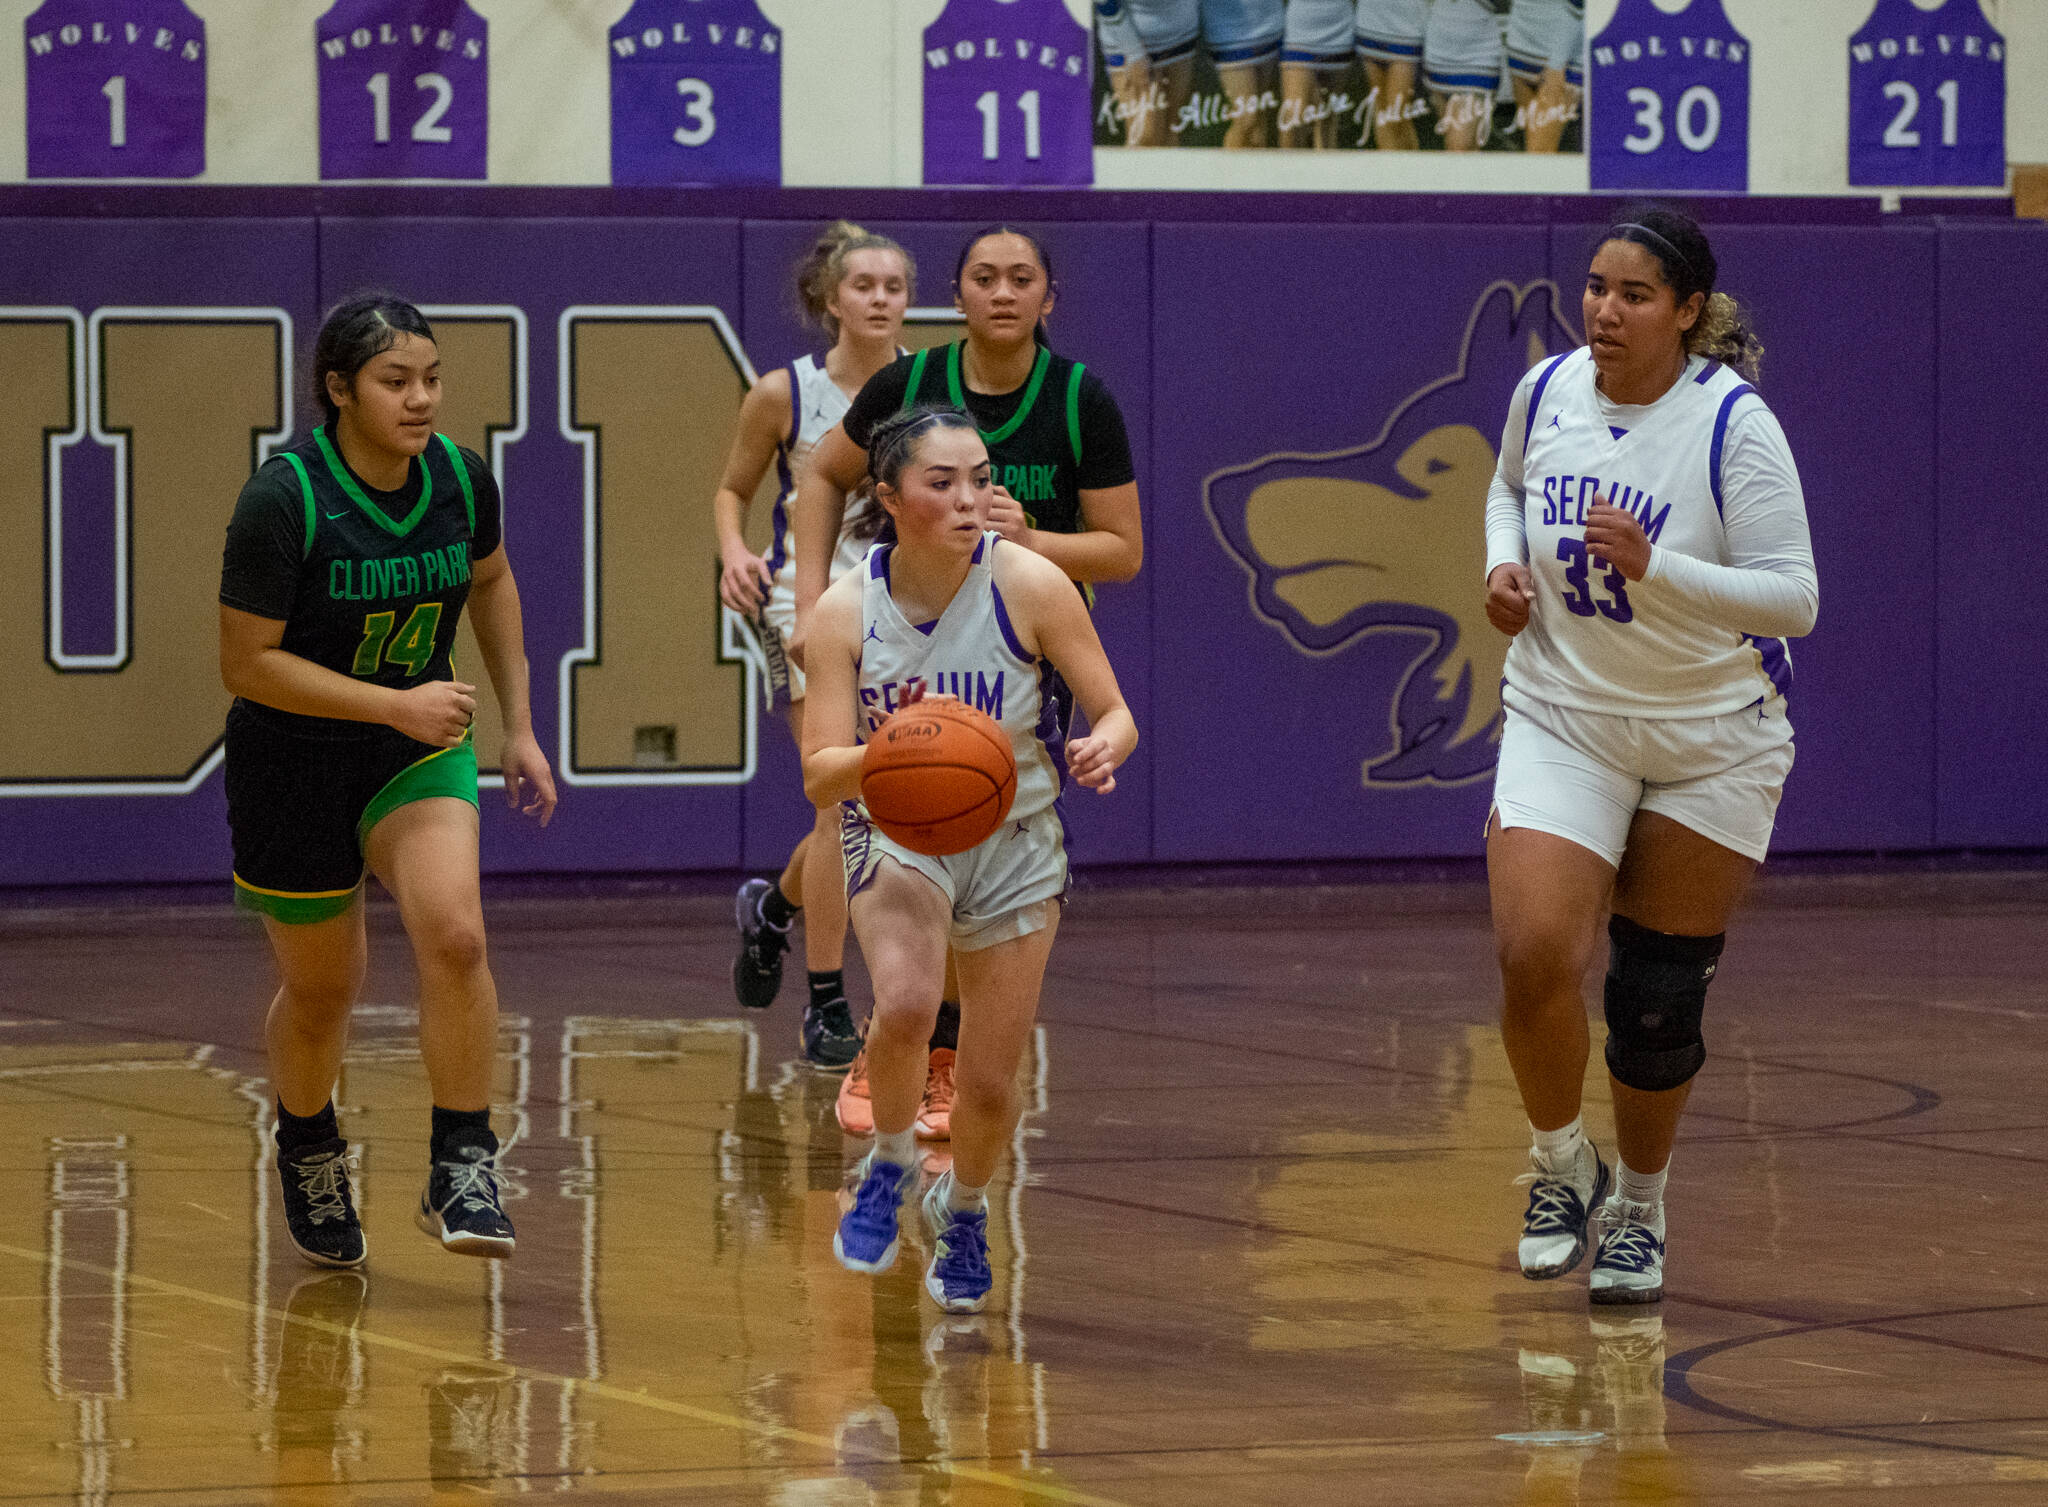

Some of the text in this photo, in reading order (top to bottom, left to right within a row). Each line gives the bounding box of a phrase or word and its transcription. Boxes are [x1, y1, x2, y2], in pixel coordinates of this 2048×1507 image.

[29, 22, 201, 61] WOLVES
[321, 23, 482, 60] WOLVES
[612, 23, 778, 58] WOLVES
[926, 38, 1082, 76] WOLVES
[1594, 36, 1744, 66] WOLVES
[1852, 34, 2002, 62] WOLVES
[101, 76, 126, 146] 1
[366, 73, 453, 142] 12
[673, 78, 716, 146] 3
[976, 91, 1040, 160] 11
[1170, 92, 1278, 132] Allison
[1623, 86, 1721, 153] 30
[1883, 80, 1958, 147] 21
[1004, 464, 1056, 500] PARK
[329, 541, 471, 600] CLOVER PARK
[1557, 537, 1633, 623] 33
[351, 602, 443, 677] 14
